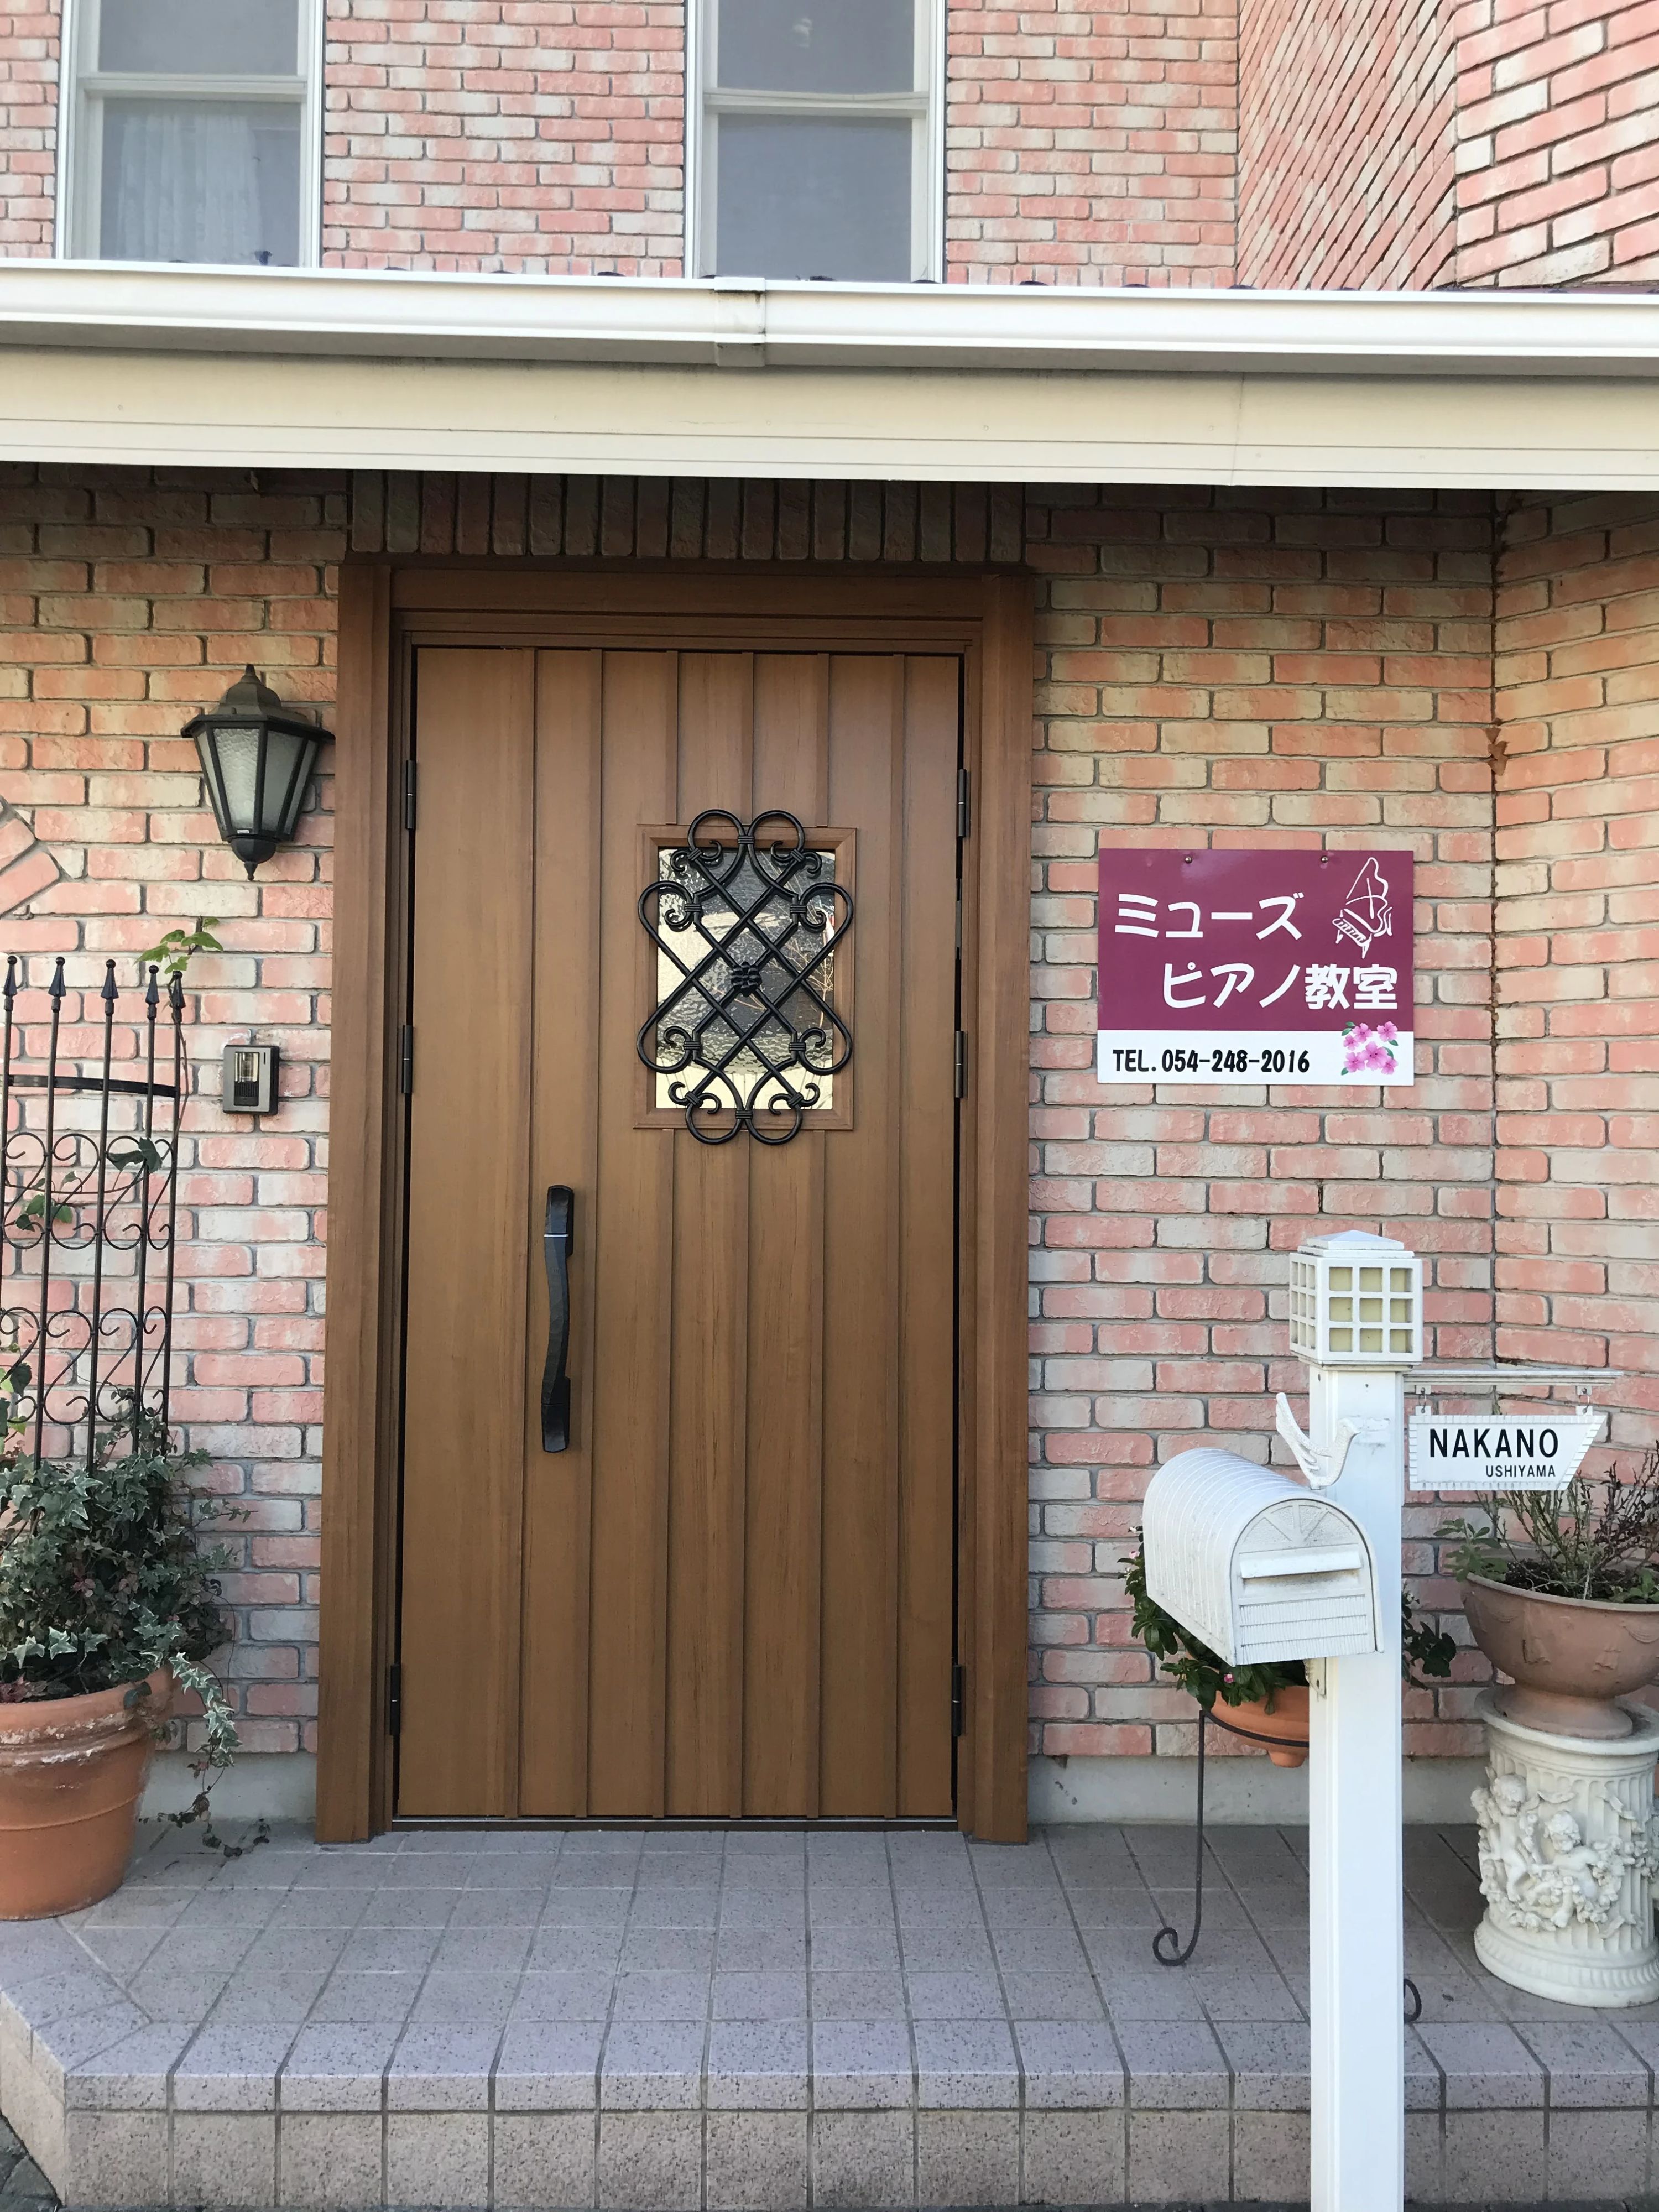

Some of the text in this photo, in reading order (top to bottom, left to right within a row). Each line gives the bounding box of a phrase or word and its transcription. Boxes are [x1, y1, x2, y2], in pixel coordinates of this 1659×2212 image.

[1114, 892, 1305, 940] ミューズ
[1163, 962, 1398, 1010] ピアノ教室
[1430, 1428, 1559, 1458] NAKANO
[1485, 1465, 1556, 1478] USHIYAMA
